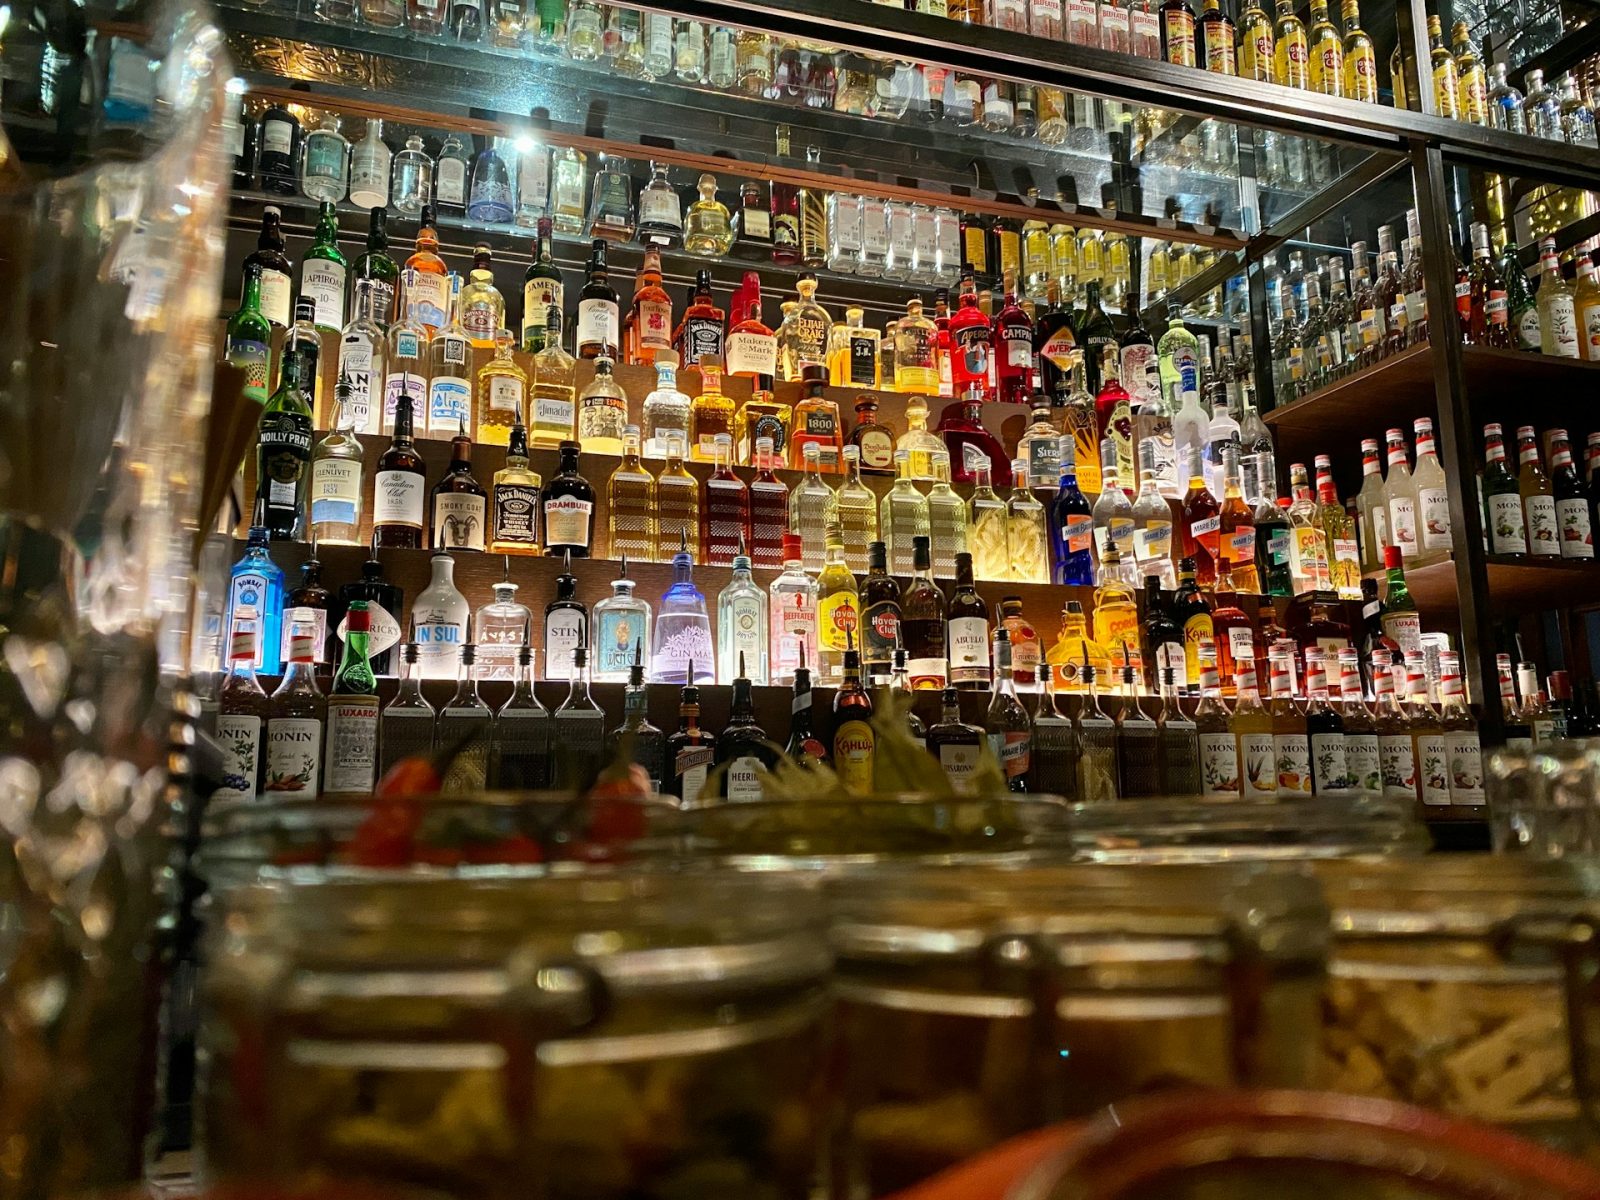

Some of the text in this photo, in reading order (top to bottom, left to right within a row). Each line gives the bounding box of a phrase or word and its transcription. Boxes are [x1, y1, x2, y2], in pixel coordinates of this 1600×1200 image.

[1069, 3, 1095, 15] BEEFEATER
[798, 317, 825, 329] ELIJAH
[798, 326, 825, 340] CRAIG
[961, 328, 989, 344] APERO
[738, 337, 774, 347] Maker's
[808, 418, 832, 430] 1800
[260, 432, 310, 447] NOILLY PRAT
[315, 468, 352, 478] GLENLIVET
[380, 477, 415, 490] Canadian
[498, 491, 537, 504] JACK DANIEL'S
[440, 502, 464, 511] SMOKY
[547, 501, 589, 512] DRAMBUIE
[1065, 526, 1080, 537] MARIE
[1194, 522, 1210, 533] MARIE
[238, 578, 262, 590] BOMBAY
[784, 611, 815, 621] BEEFEATER
[434, 627, 460, 644] SUL
[954, 635, 984, 645] ABUELO
[671, 648, 691, 658] GIN
[1002, 748, 1019, 759] MARIE
[732, 772, 761, 782] HEERIN
